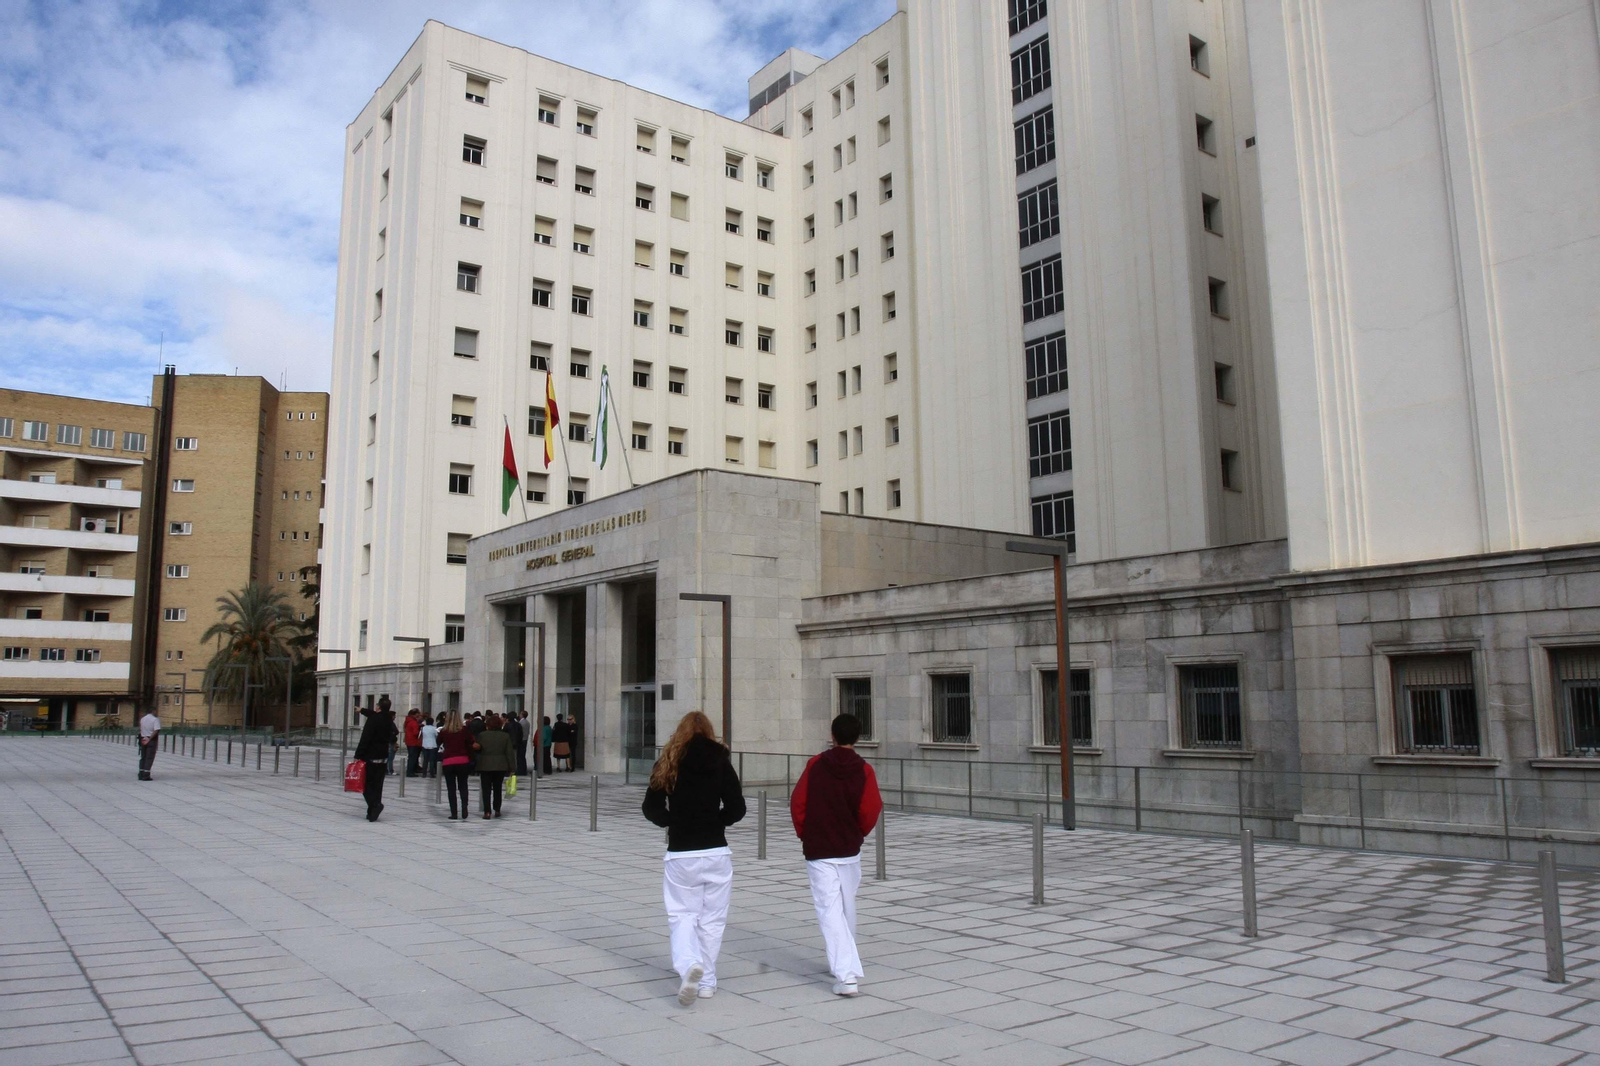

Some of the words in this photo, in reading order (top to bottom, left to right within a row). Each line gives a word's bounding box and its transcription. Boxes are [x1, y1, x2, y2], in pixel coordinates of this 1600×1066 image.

[489, 545, 514, 562] HOSPITAL
[516, 532, 561, 555] UNIVERSITARIO
[564, 525, 589, 542] VIRGEN
[591, 522, 600, 535] DE
[601, 517, 616, 533] LAS
[618, 509, 647, 528] NIEVES
[526, 554, 558, 571] HOSPITAL
[561, 545, 595, 562] GENERAL
